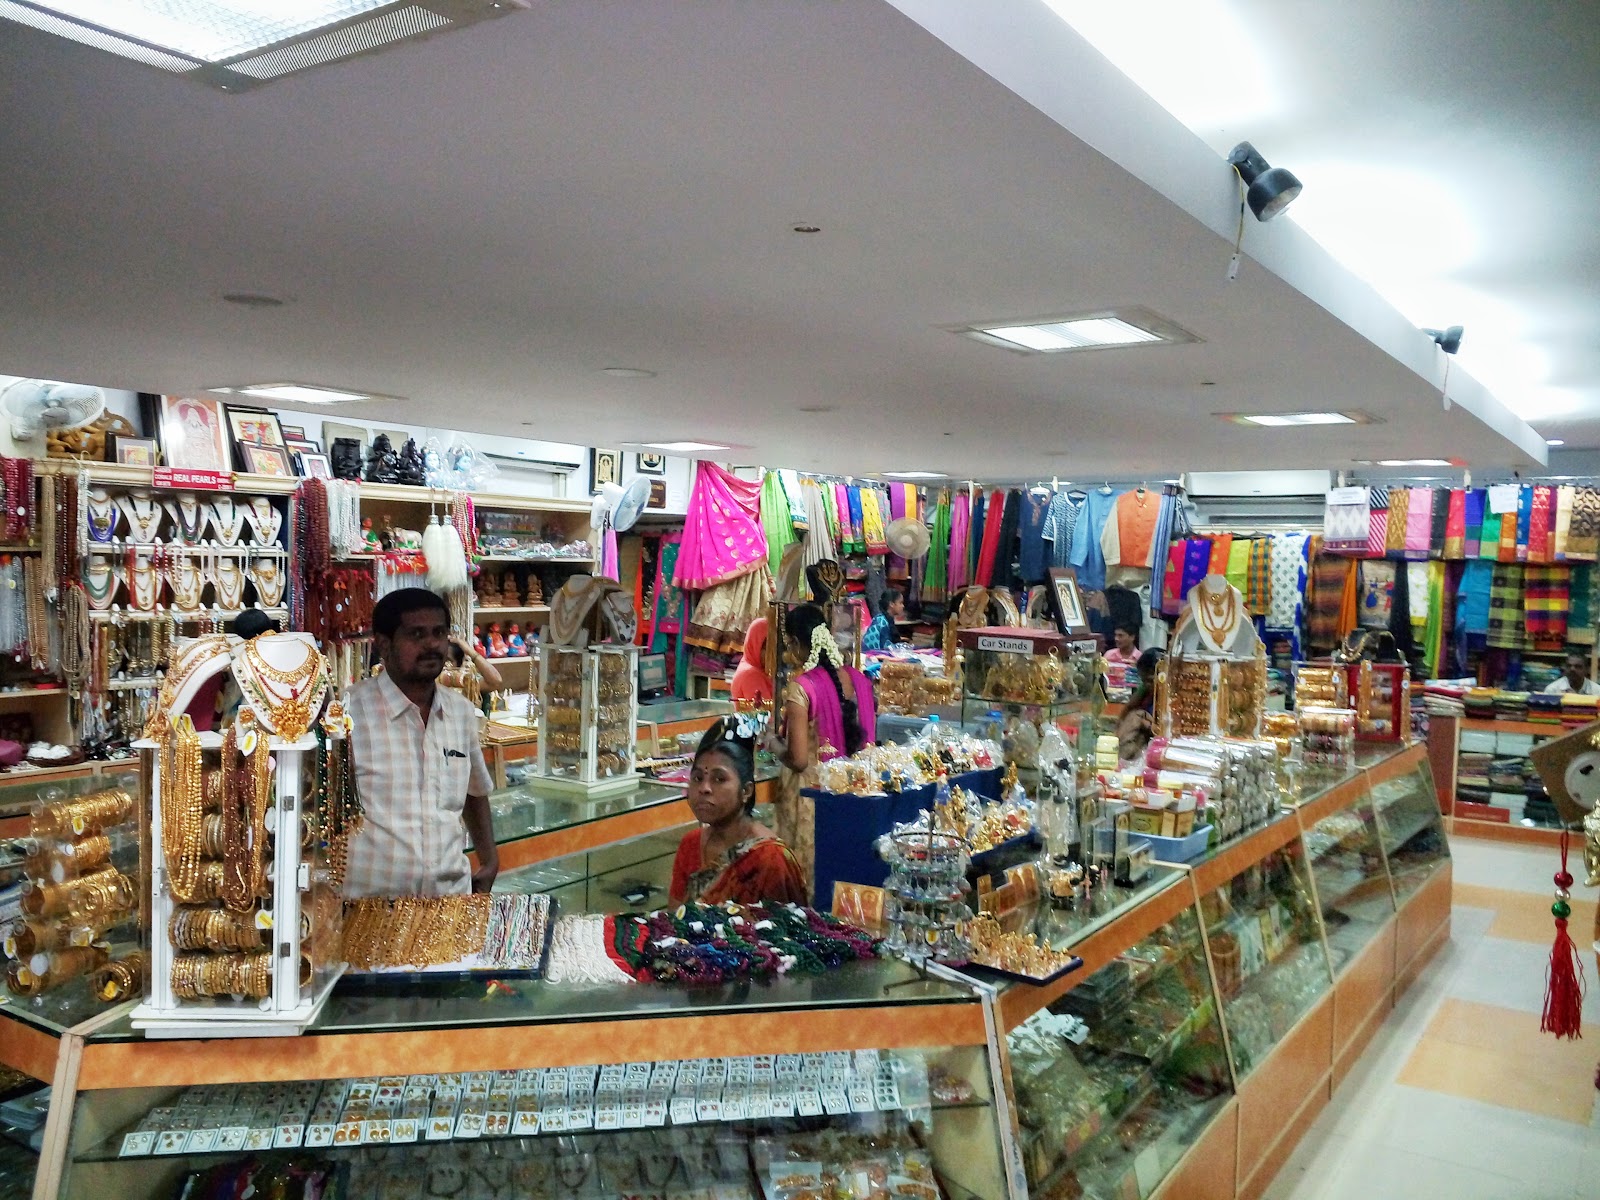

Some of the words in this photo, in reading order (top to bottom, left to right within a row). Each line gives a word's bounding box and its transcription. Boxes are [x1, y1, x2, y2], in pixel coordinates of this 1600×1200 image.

[173, 473, 190, 483] REAL
[191, 474, 217, 485] PEARLS
[981, 639, 995, 648] Car
[998, 640, 1028, 651] Stands
